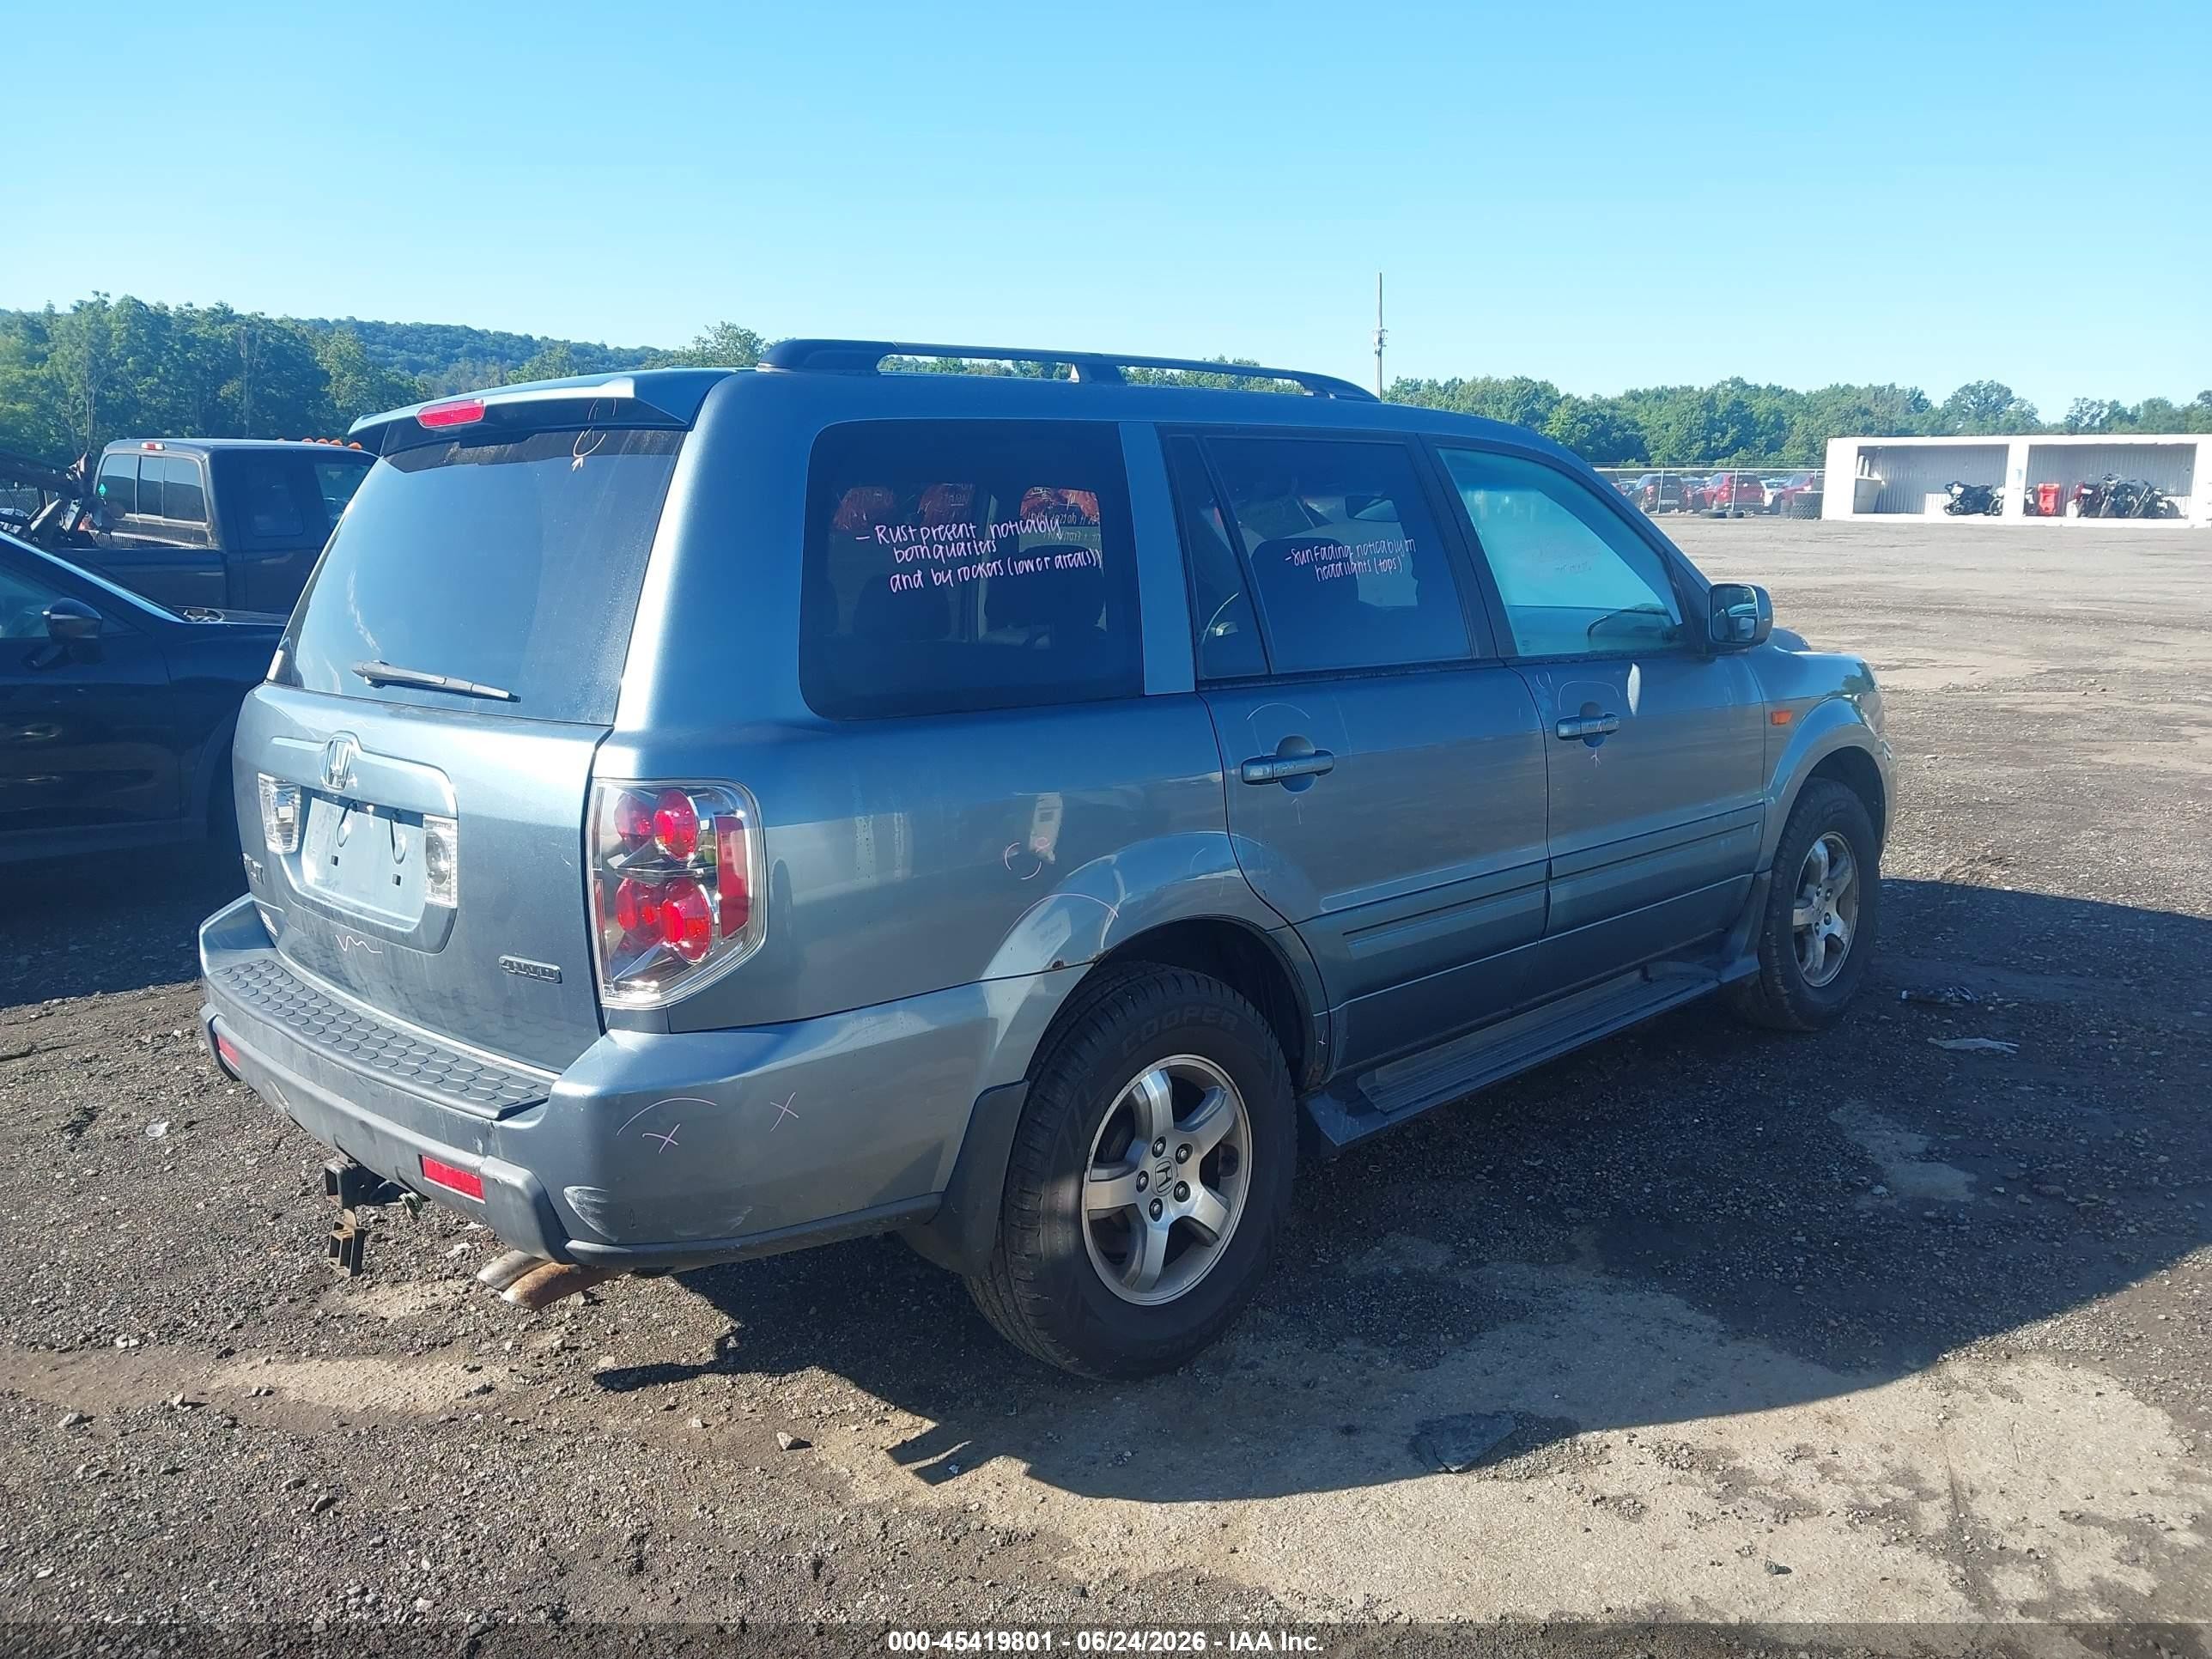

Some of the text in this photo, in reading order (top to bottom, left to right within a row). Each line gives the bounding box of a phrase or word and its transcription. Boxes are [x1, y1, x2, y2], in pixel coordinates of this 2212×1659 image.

[874, 525, 918, 545] Rust
[920, 521, 977, 545] present
[989, 516, 1062, 541] noticably
[933, 539, 997, 564] quarters
[890, 568, 924, 592] and
[930, 568, 954, 587] by
[957, 559, 1004, 582] rockers
[1374, 555, 1403, 576] (tops)
